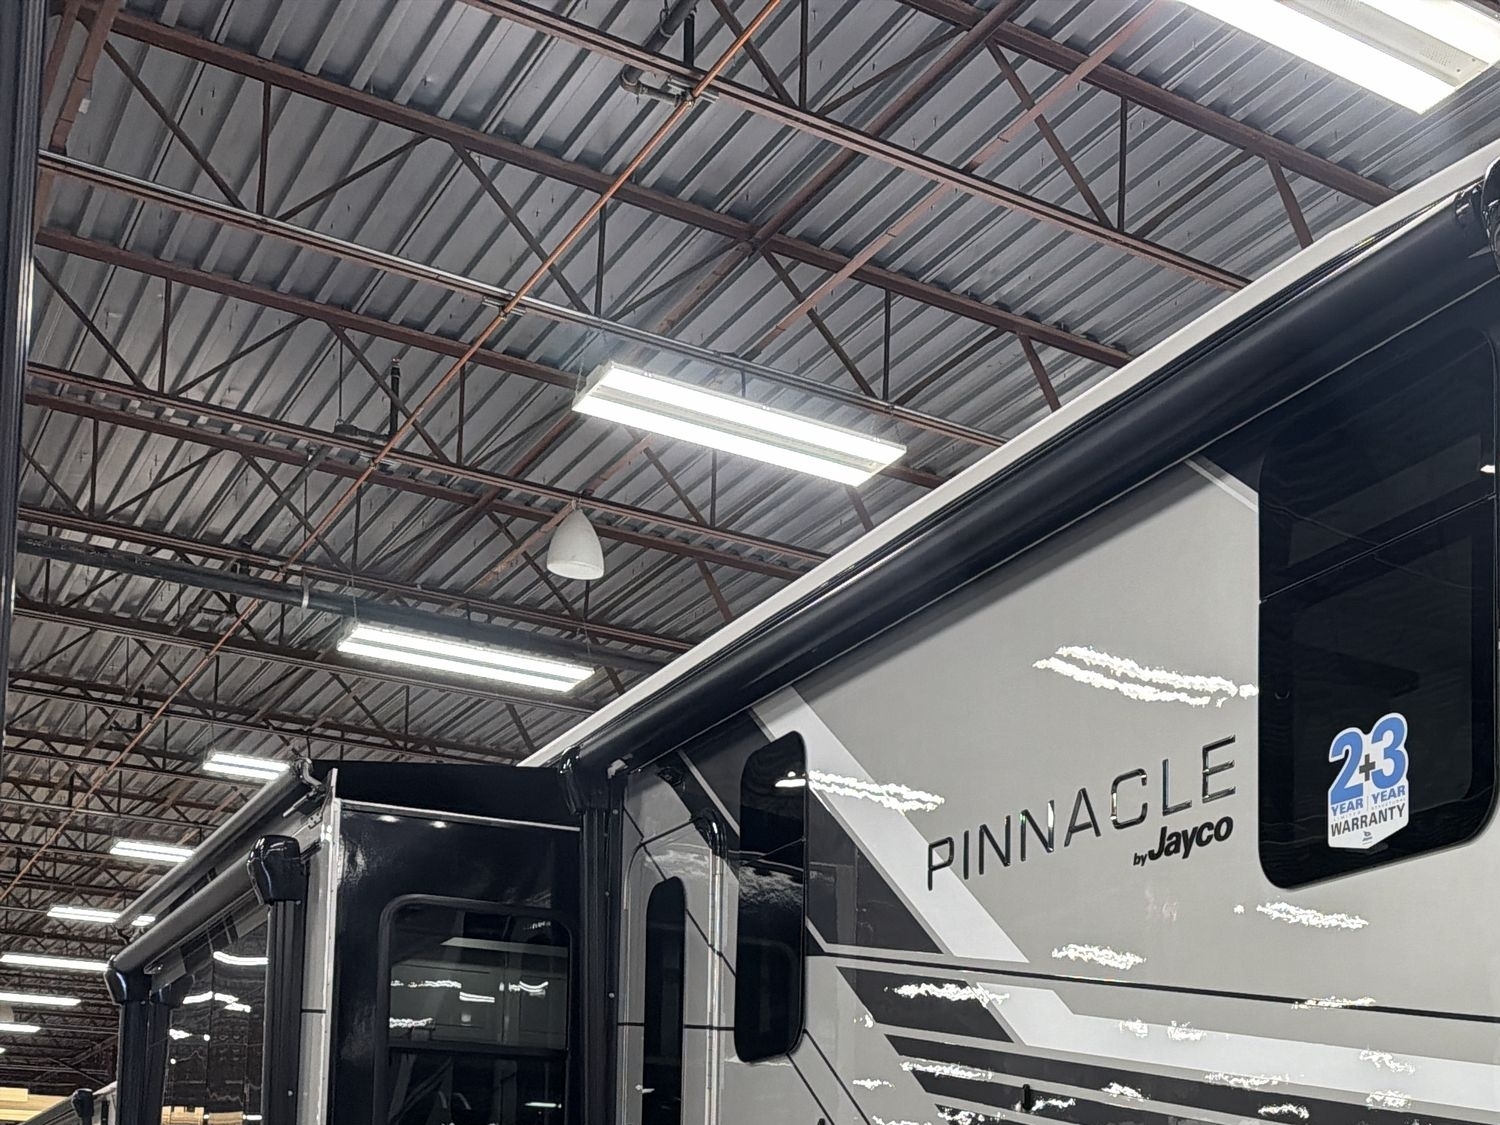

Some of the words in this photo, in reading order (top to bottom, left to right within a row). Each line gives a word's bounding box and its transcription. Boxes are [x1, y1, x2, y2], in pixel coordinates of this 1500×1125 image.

[928, 735, 1236, 890] PINNACLE
[1331, 803, 1405, 837] WARRANTY
[1332, 797, 1363, 817] YEAR
[1371, 785, 1405, 804] YEAR
[1133, 853, 1147, 867] by
[1148, 816, 1234, 861] Jayco
